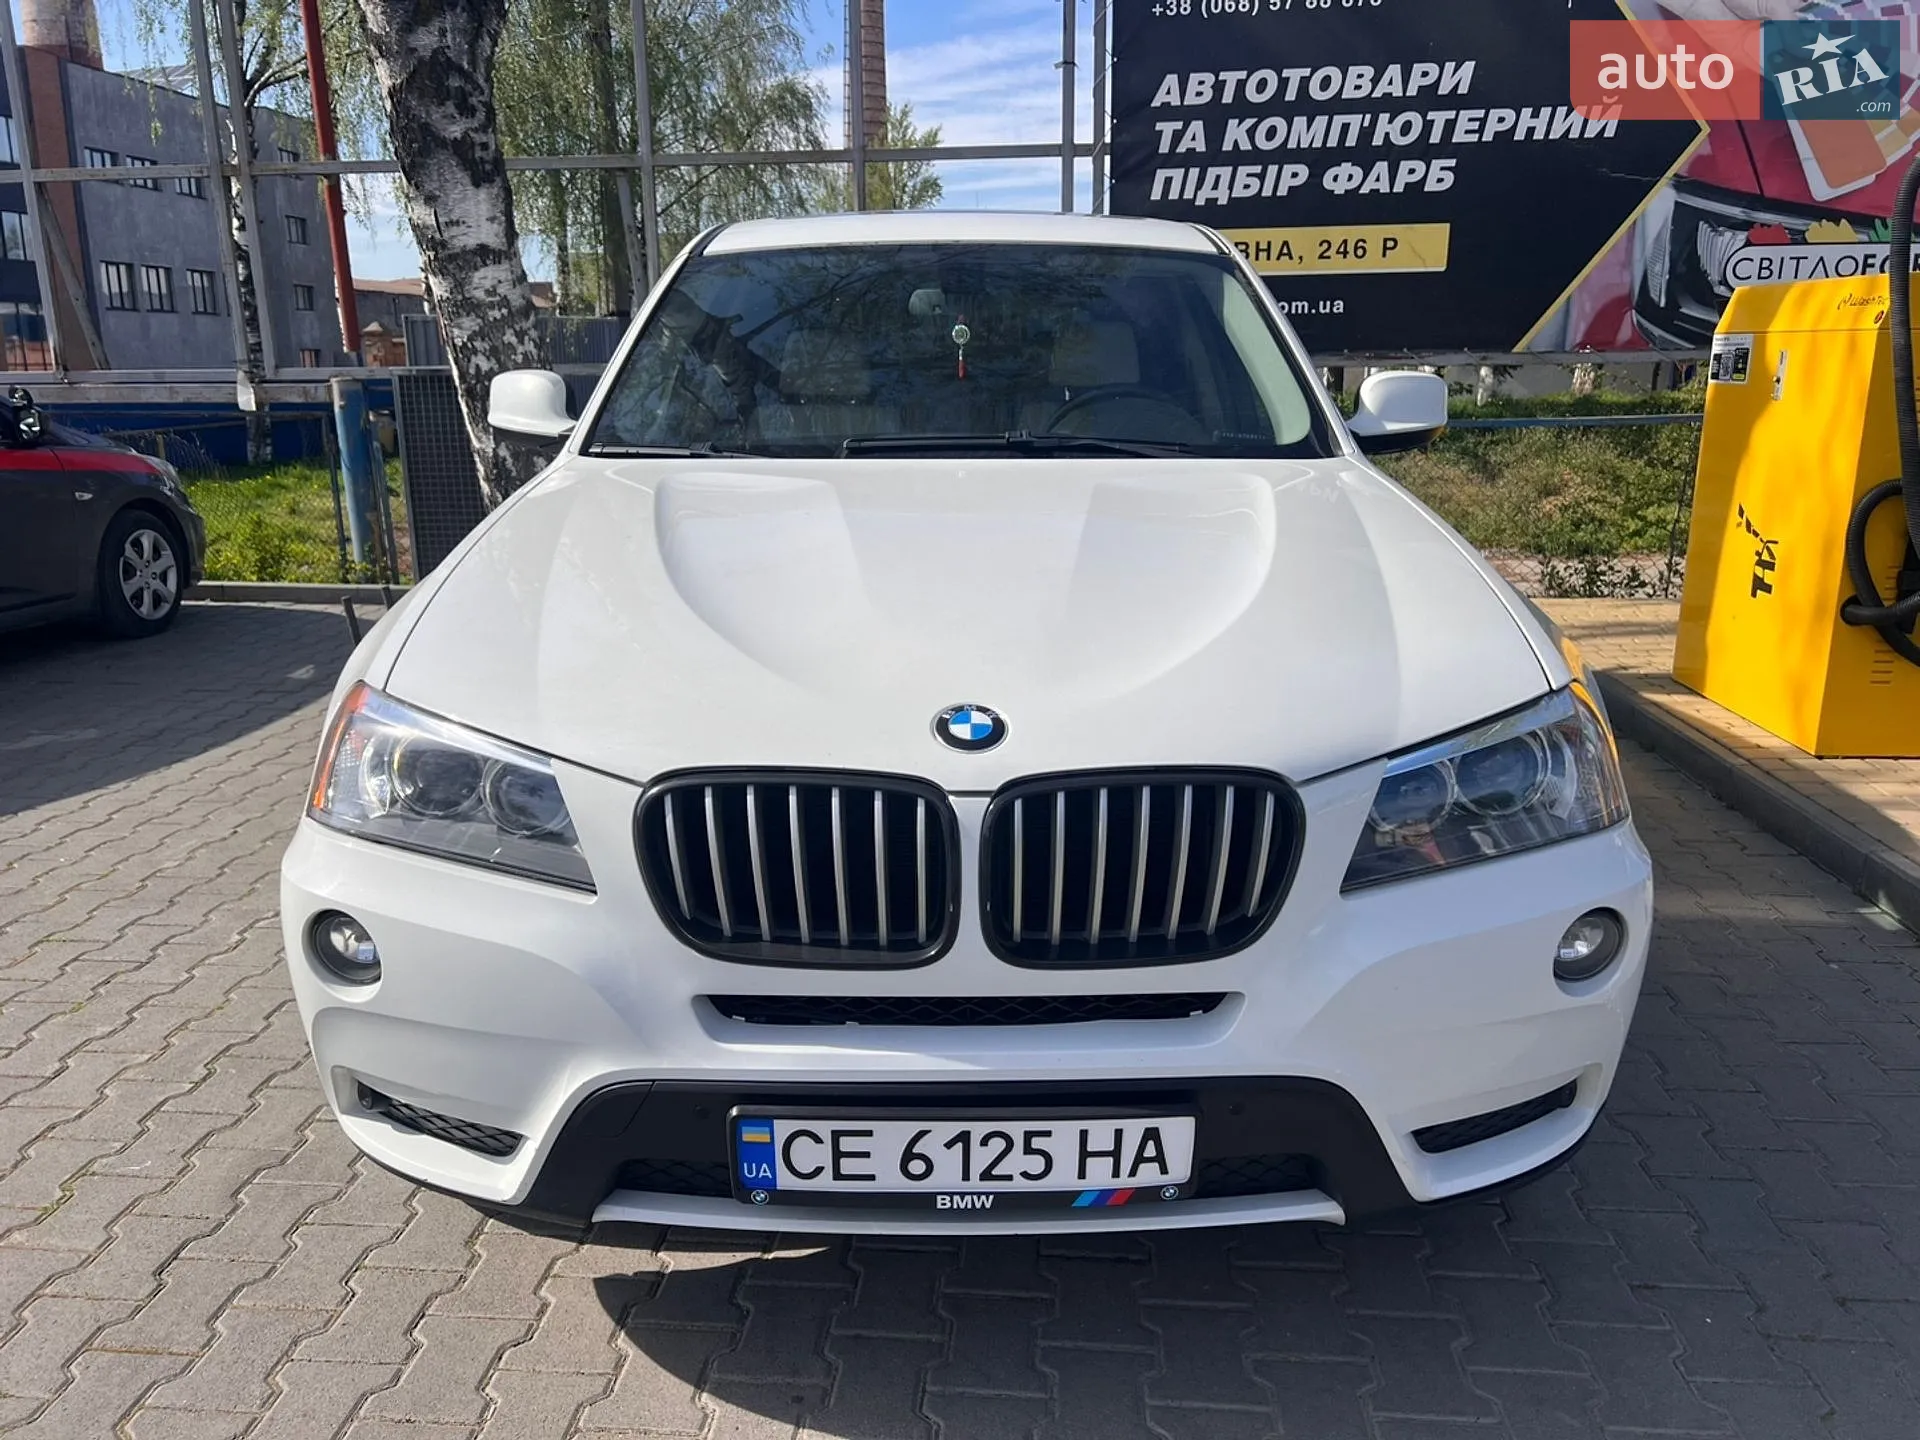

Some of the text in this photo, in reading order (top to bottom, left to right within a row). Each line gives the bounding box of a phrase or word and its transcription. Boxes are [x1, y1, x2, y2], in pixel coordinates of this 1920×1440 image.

[1150, 60, 1476, 108] АВТОТОВАРИ
[1154, 96, 1623, 154] ТА КОМП'ЮТЕРНИЙ
[1149, 158, 1457, 206] ПІДБІР ФАРБ
[1318, 238, 1368, 260] 246
[1382, 237, 1399, 258] Р
[743, 1161, 772, 1179] UA
[781, 1126, 1170, 1182] CE 6125 HA
[936, 1194, 994, 1210] BMW
